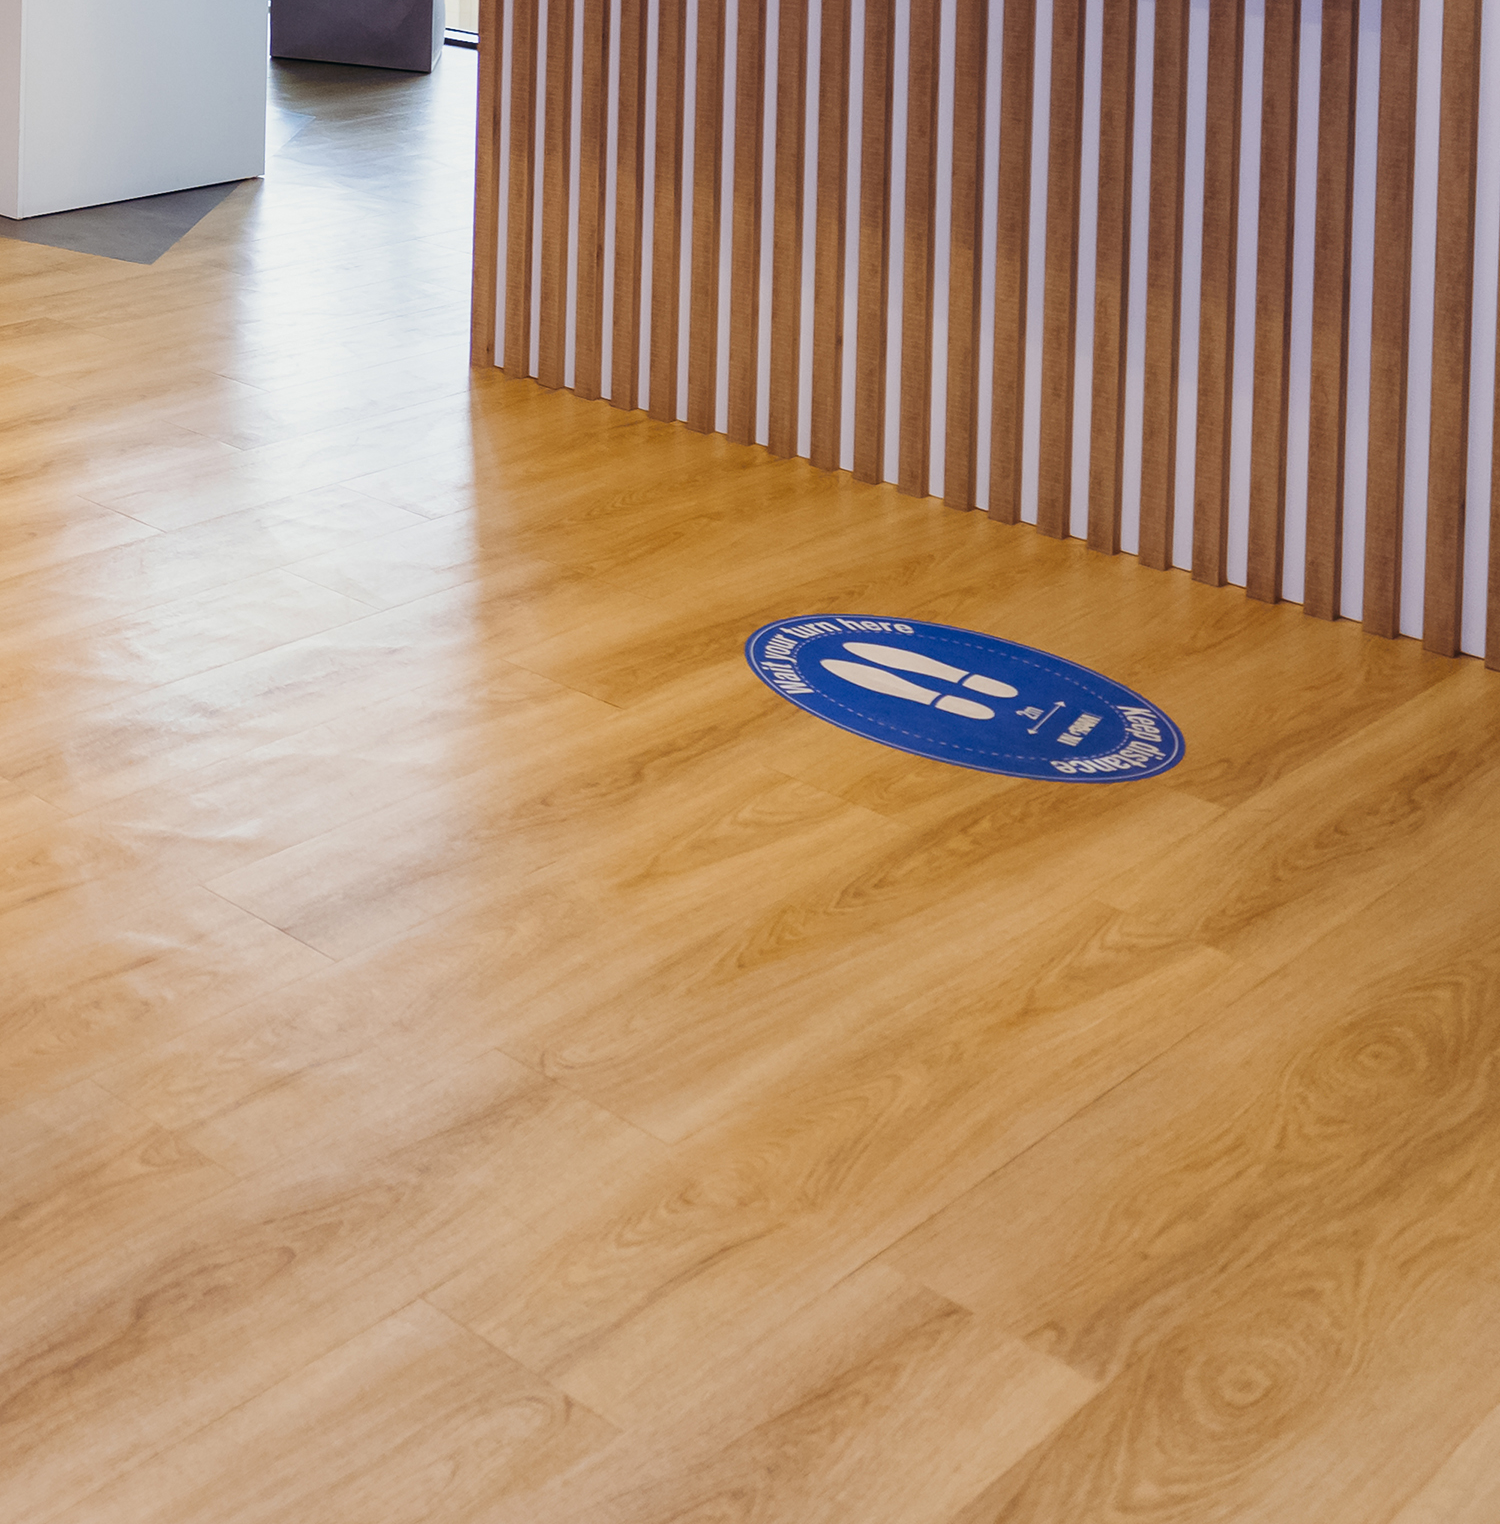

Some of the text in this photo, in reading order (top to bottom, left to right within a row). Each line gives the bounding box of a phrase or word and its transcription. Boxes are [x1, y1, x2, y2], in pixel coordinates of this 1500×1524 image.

[760, 618, 915, 694] Wait your turn here
[1015, 706, 1045, 721] 2m
[1050, 705, 1166, 774] Keep distance
